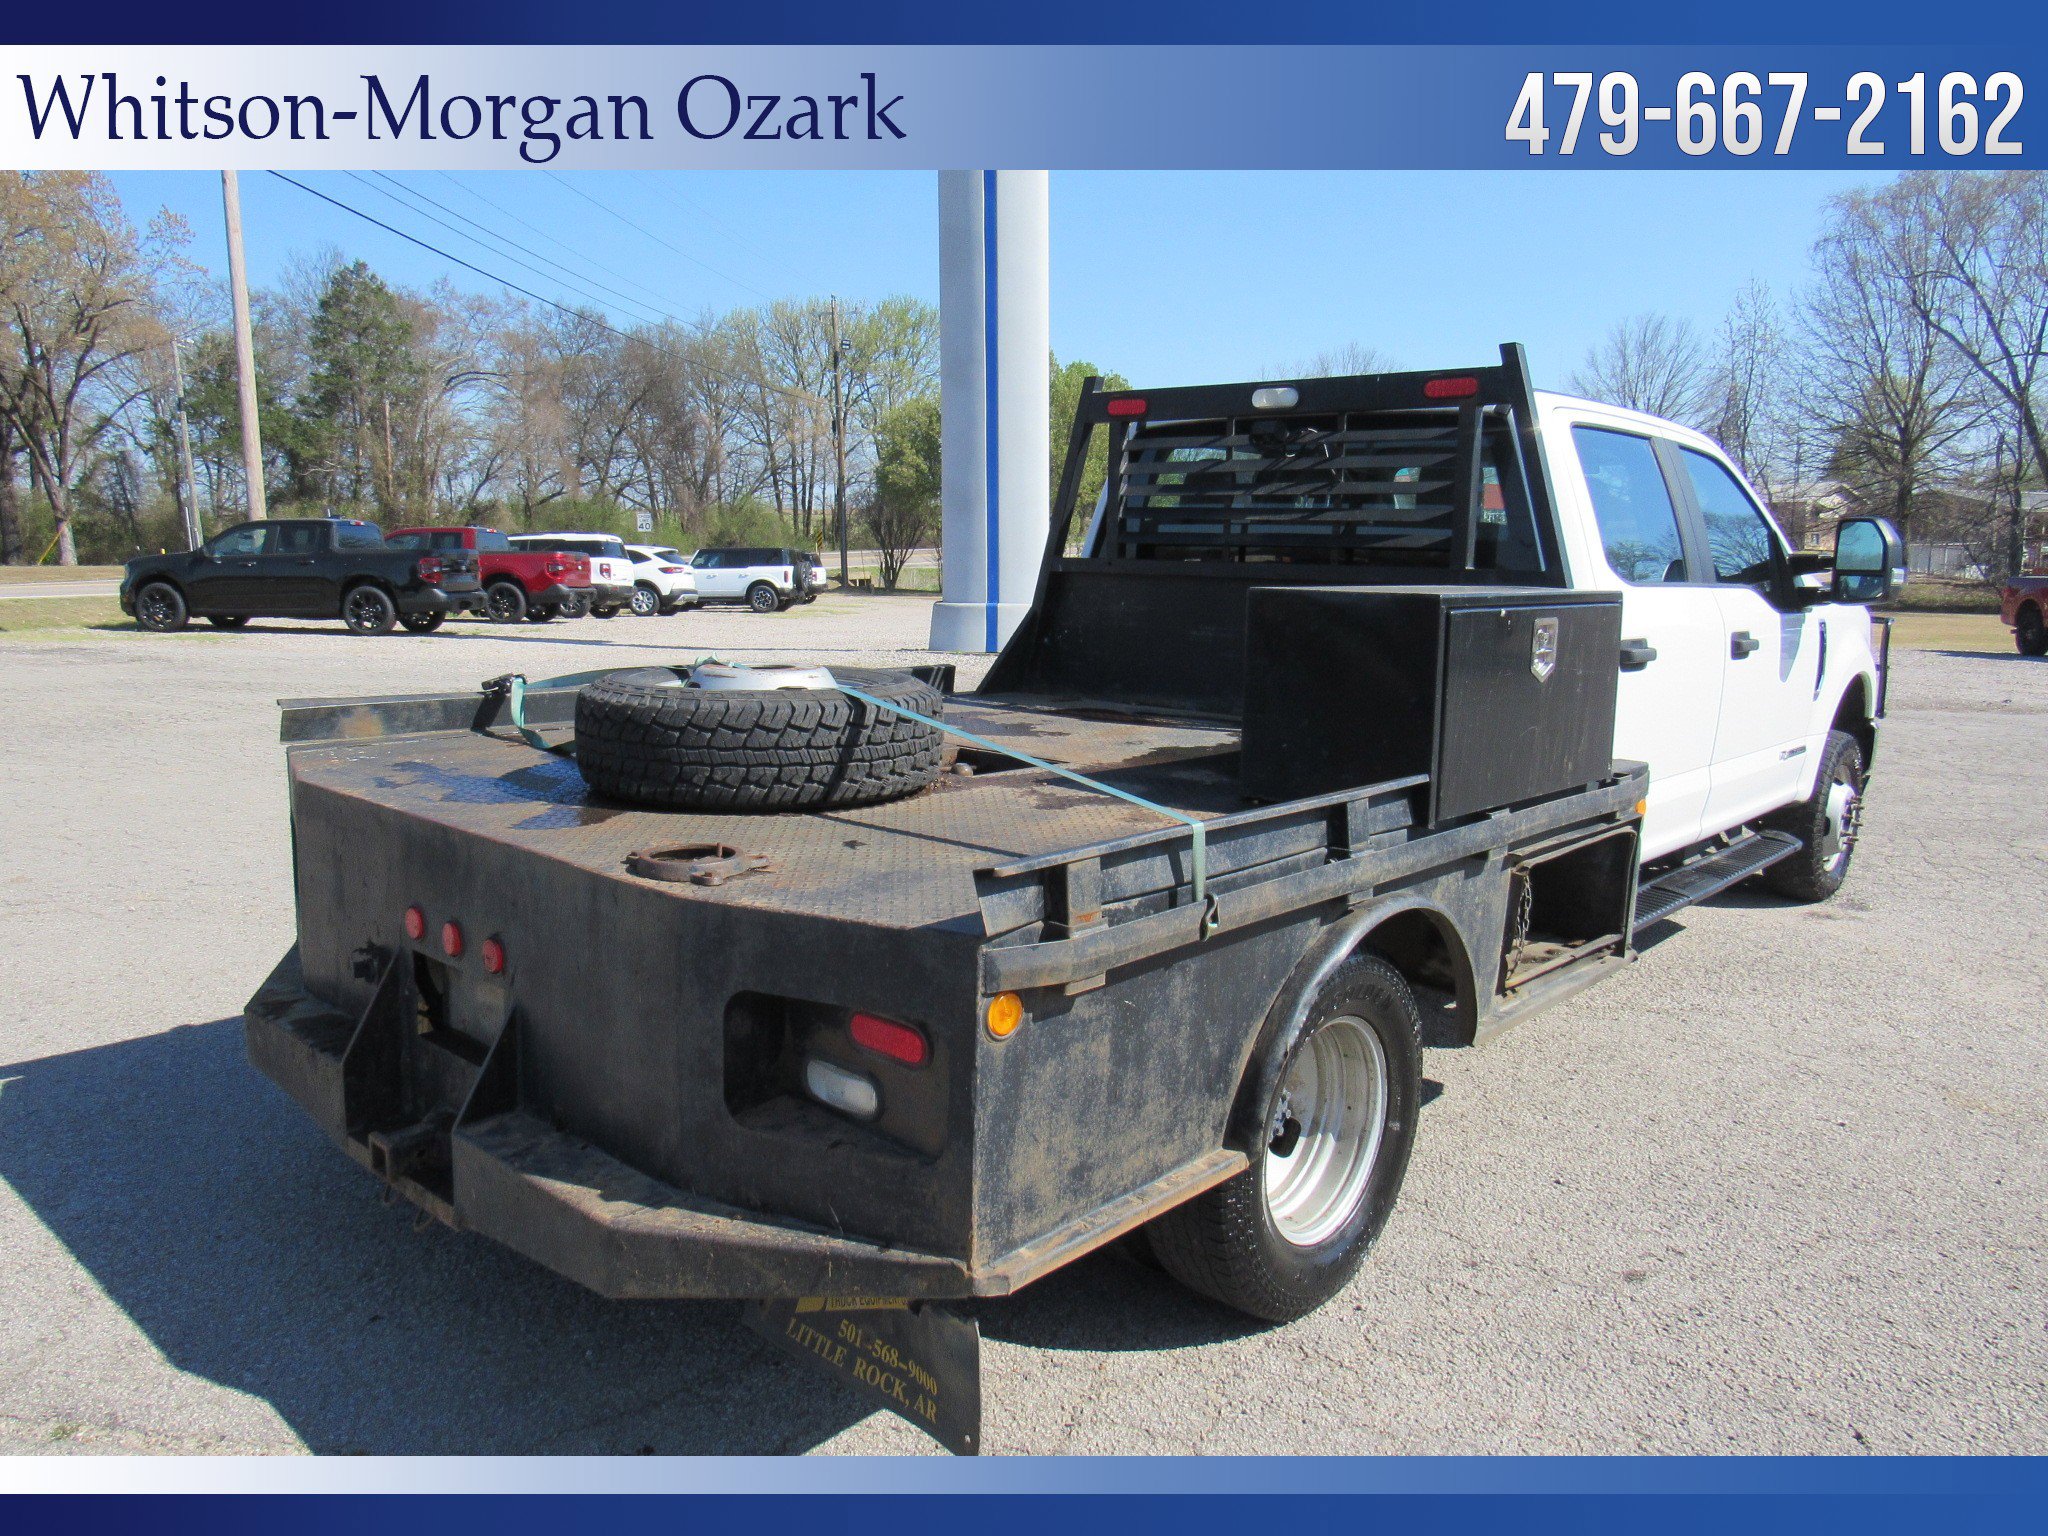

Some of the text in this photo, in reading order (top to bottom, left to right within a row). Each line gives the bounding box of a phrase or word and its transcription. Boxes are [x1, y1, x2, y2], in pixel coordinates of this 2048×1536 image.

[639, 522, 650, 530] 40
[786, 1317, 938, 1424] LITTLE ROCK, AR
[838, 1318, 938, 1396] 501-568-9000
